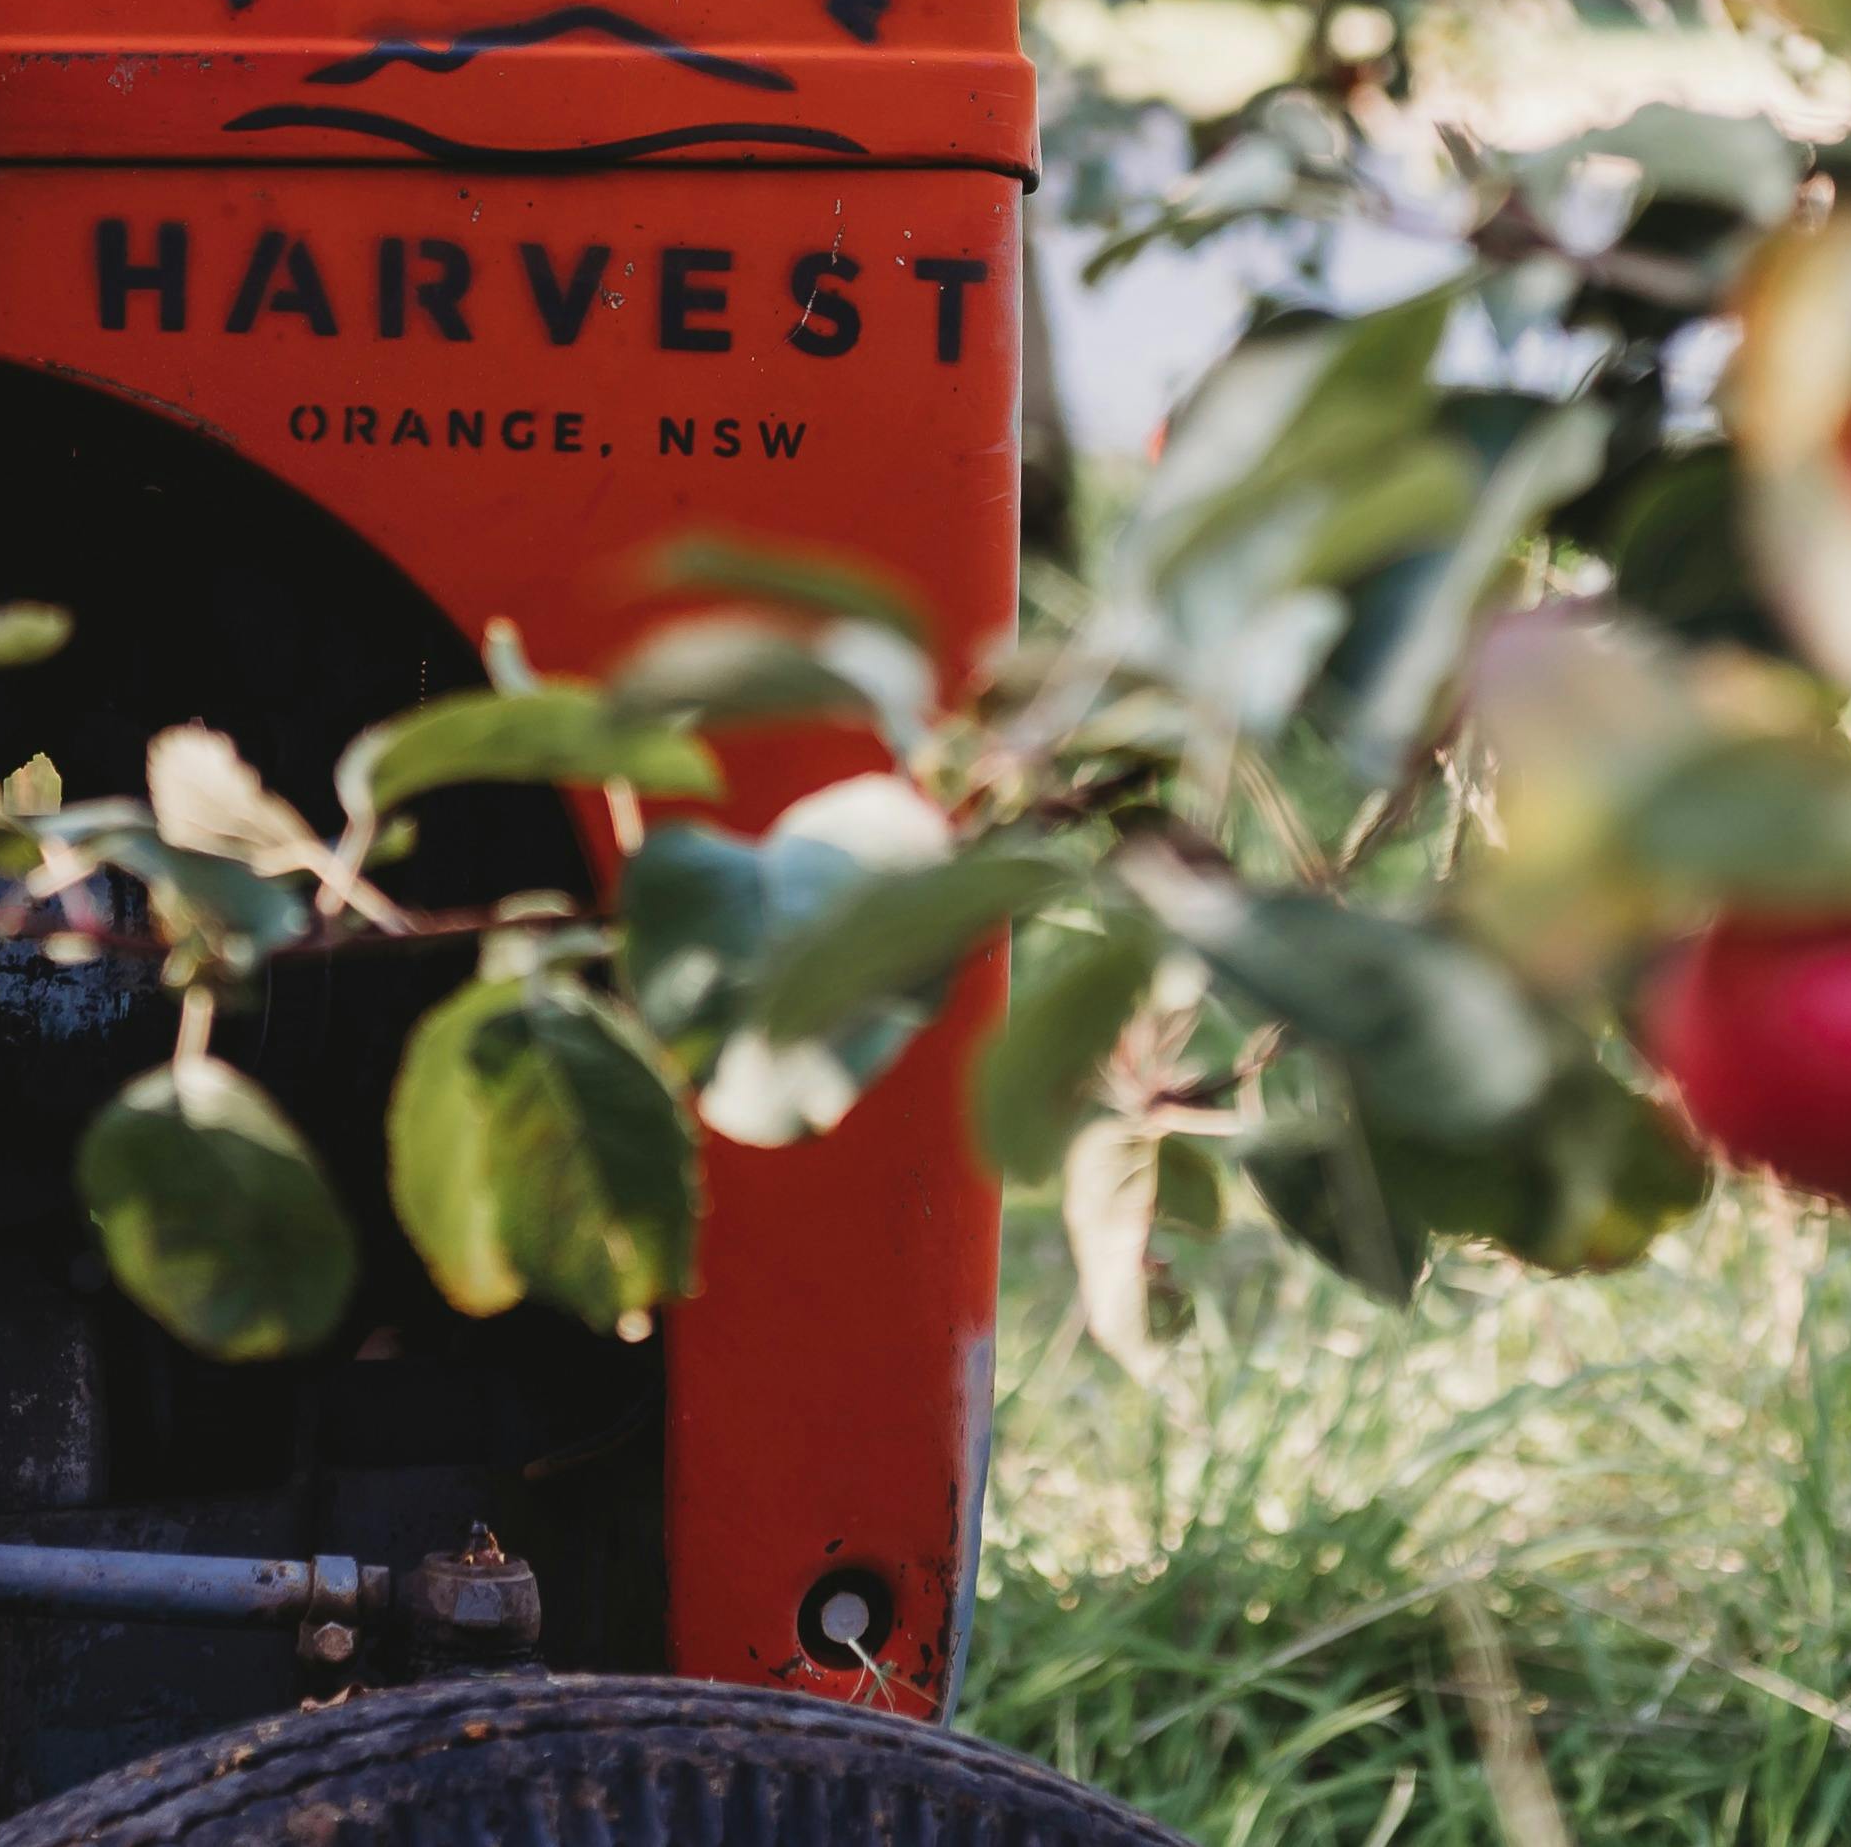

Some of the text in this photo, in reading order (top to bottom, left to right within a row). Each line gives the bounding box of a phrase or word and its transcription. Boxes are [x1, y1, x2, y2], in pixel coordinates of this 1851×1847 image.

[93, 219, 988, 364] HARVEST
[288, 404, 807, 460] ORANGE, NSW
